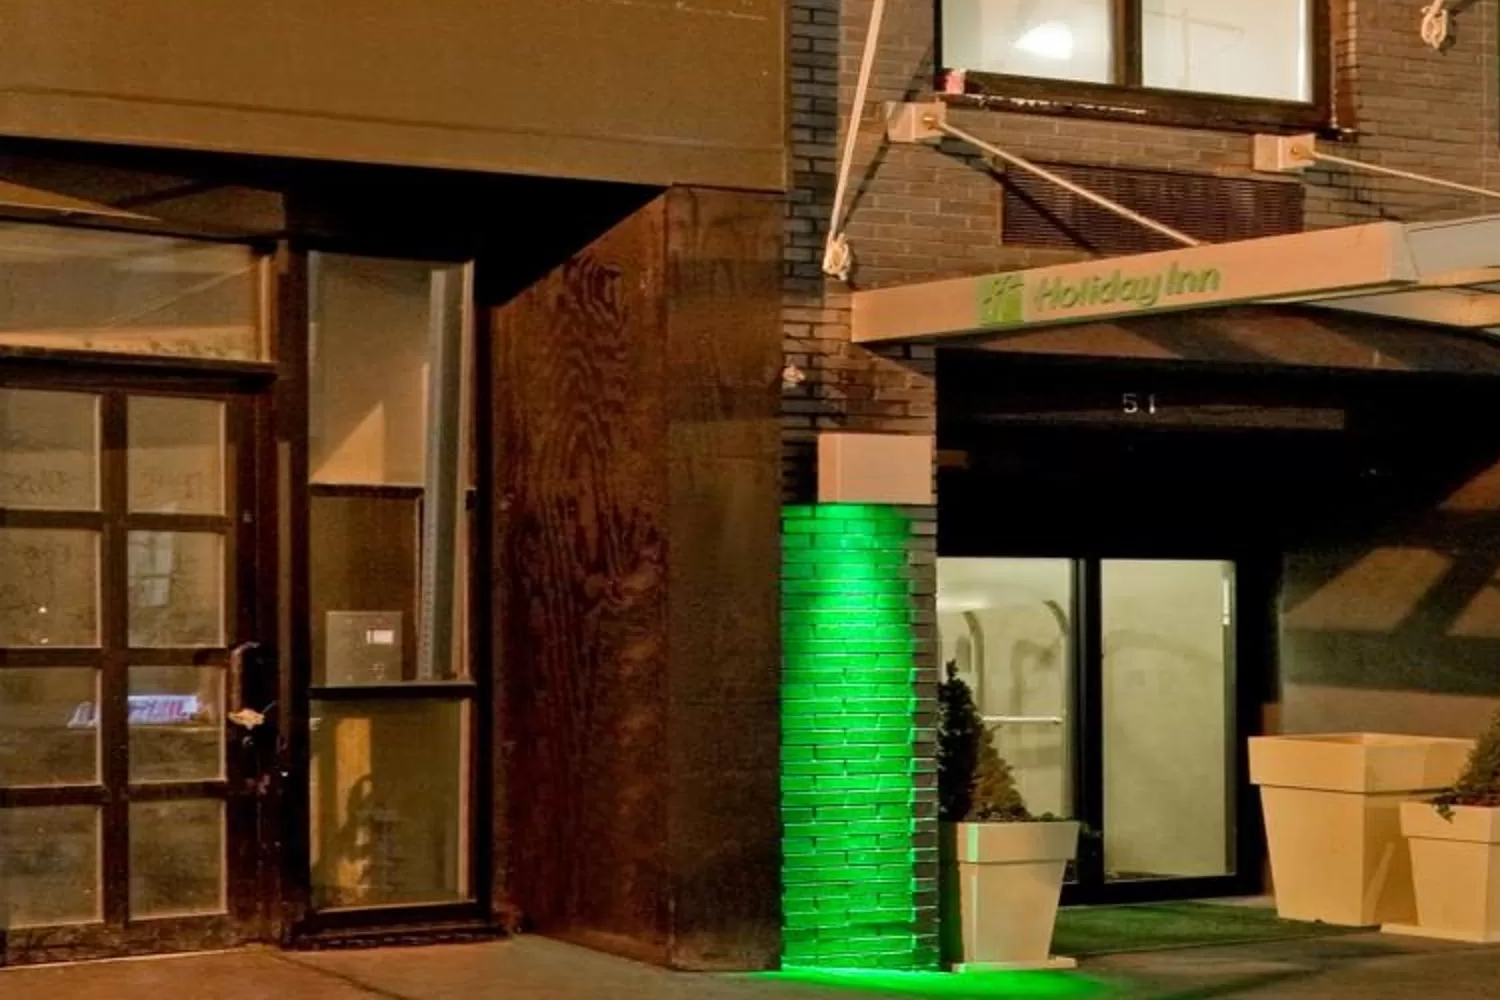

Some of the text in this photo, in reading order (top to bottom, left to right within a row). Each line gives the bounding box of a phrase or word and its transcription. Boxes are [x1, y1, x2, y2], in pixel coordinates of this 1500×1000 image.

[1034, 260, 1221, 312] Holiday Inn
[1121, 392, 1156, 415] 51
